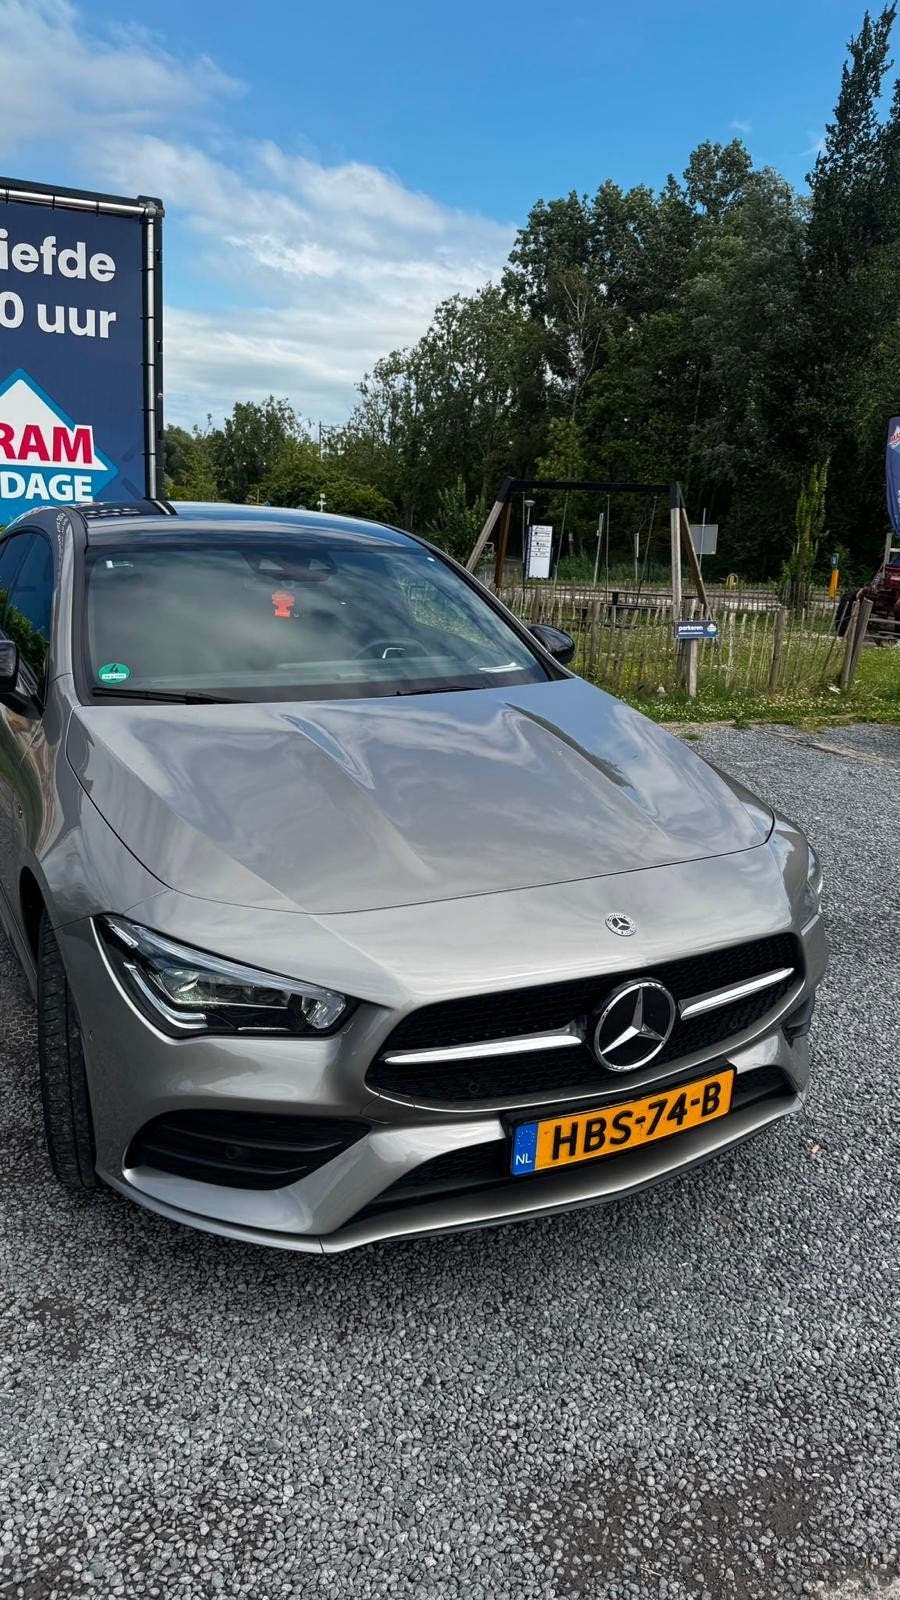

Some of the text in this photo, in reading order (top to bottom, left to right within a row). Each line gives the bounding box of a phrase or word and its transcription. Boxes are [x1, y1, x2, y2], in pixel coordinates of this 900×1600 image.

[0, 291, 116, 338] 0 uur
[1, 471, 93, 502] DAGE
[109, 663, 118, 673] 4
[552, 1081, 721, 1159] HBS-74-B
[515, 1153, 532, 1166] NL
